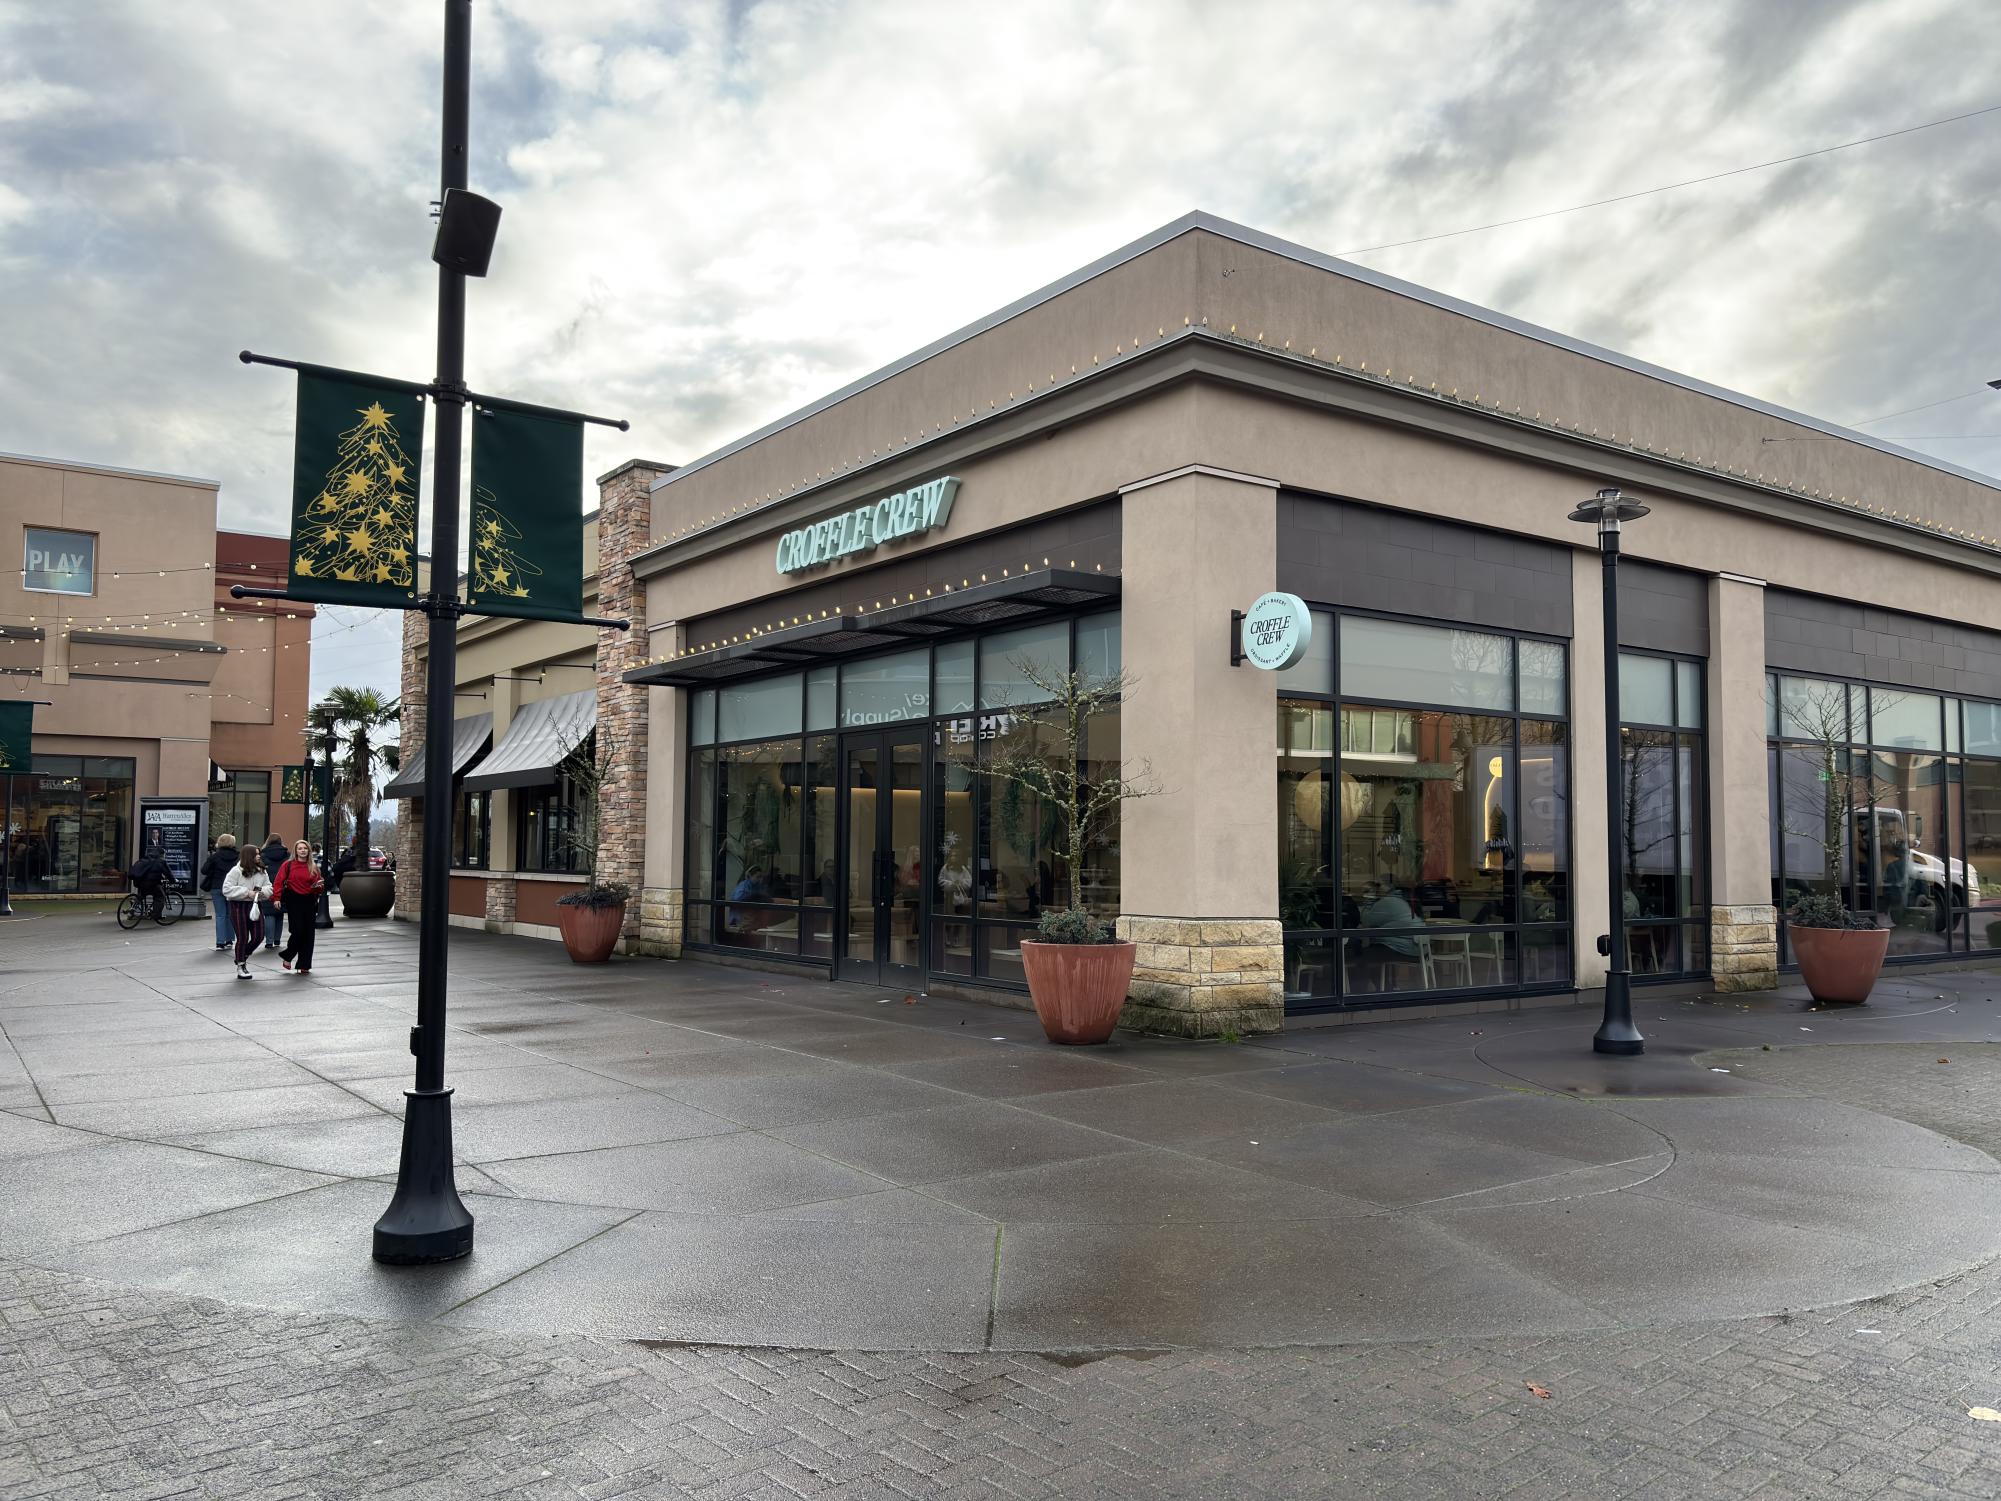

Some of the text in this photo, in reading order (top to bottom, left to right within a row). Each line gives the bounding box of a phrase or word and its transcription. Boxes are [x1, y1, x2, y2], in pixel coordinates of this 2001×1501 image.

[776, 475, 957, 575] CROFFLE CREW
[29, 549, 85, 575] PLAY
[1250, 615, 1291, 634] CROFFLE
[1256, 629, 1285, 646] CREW
